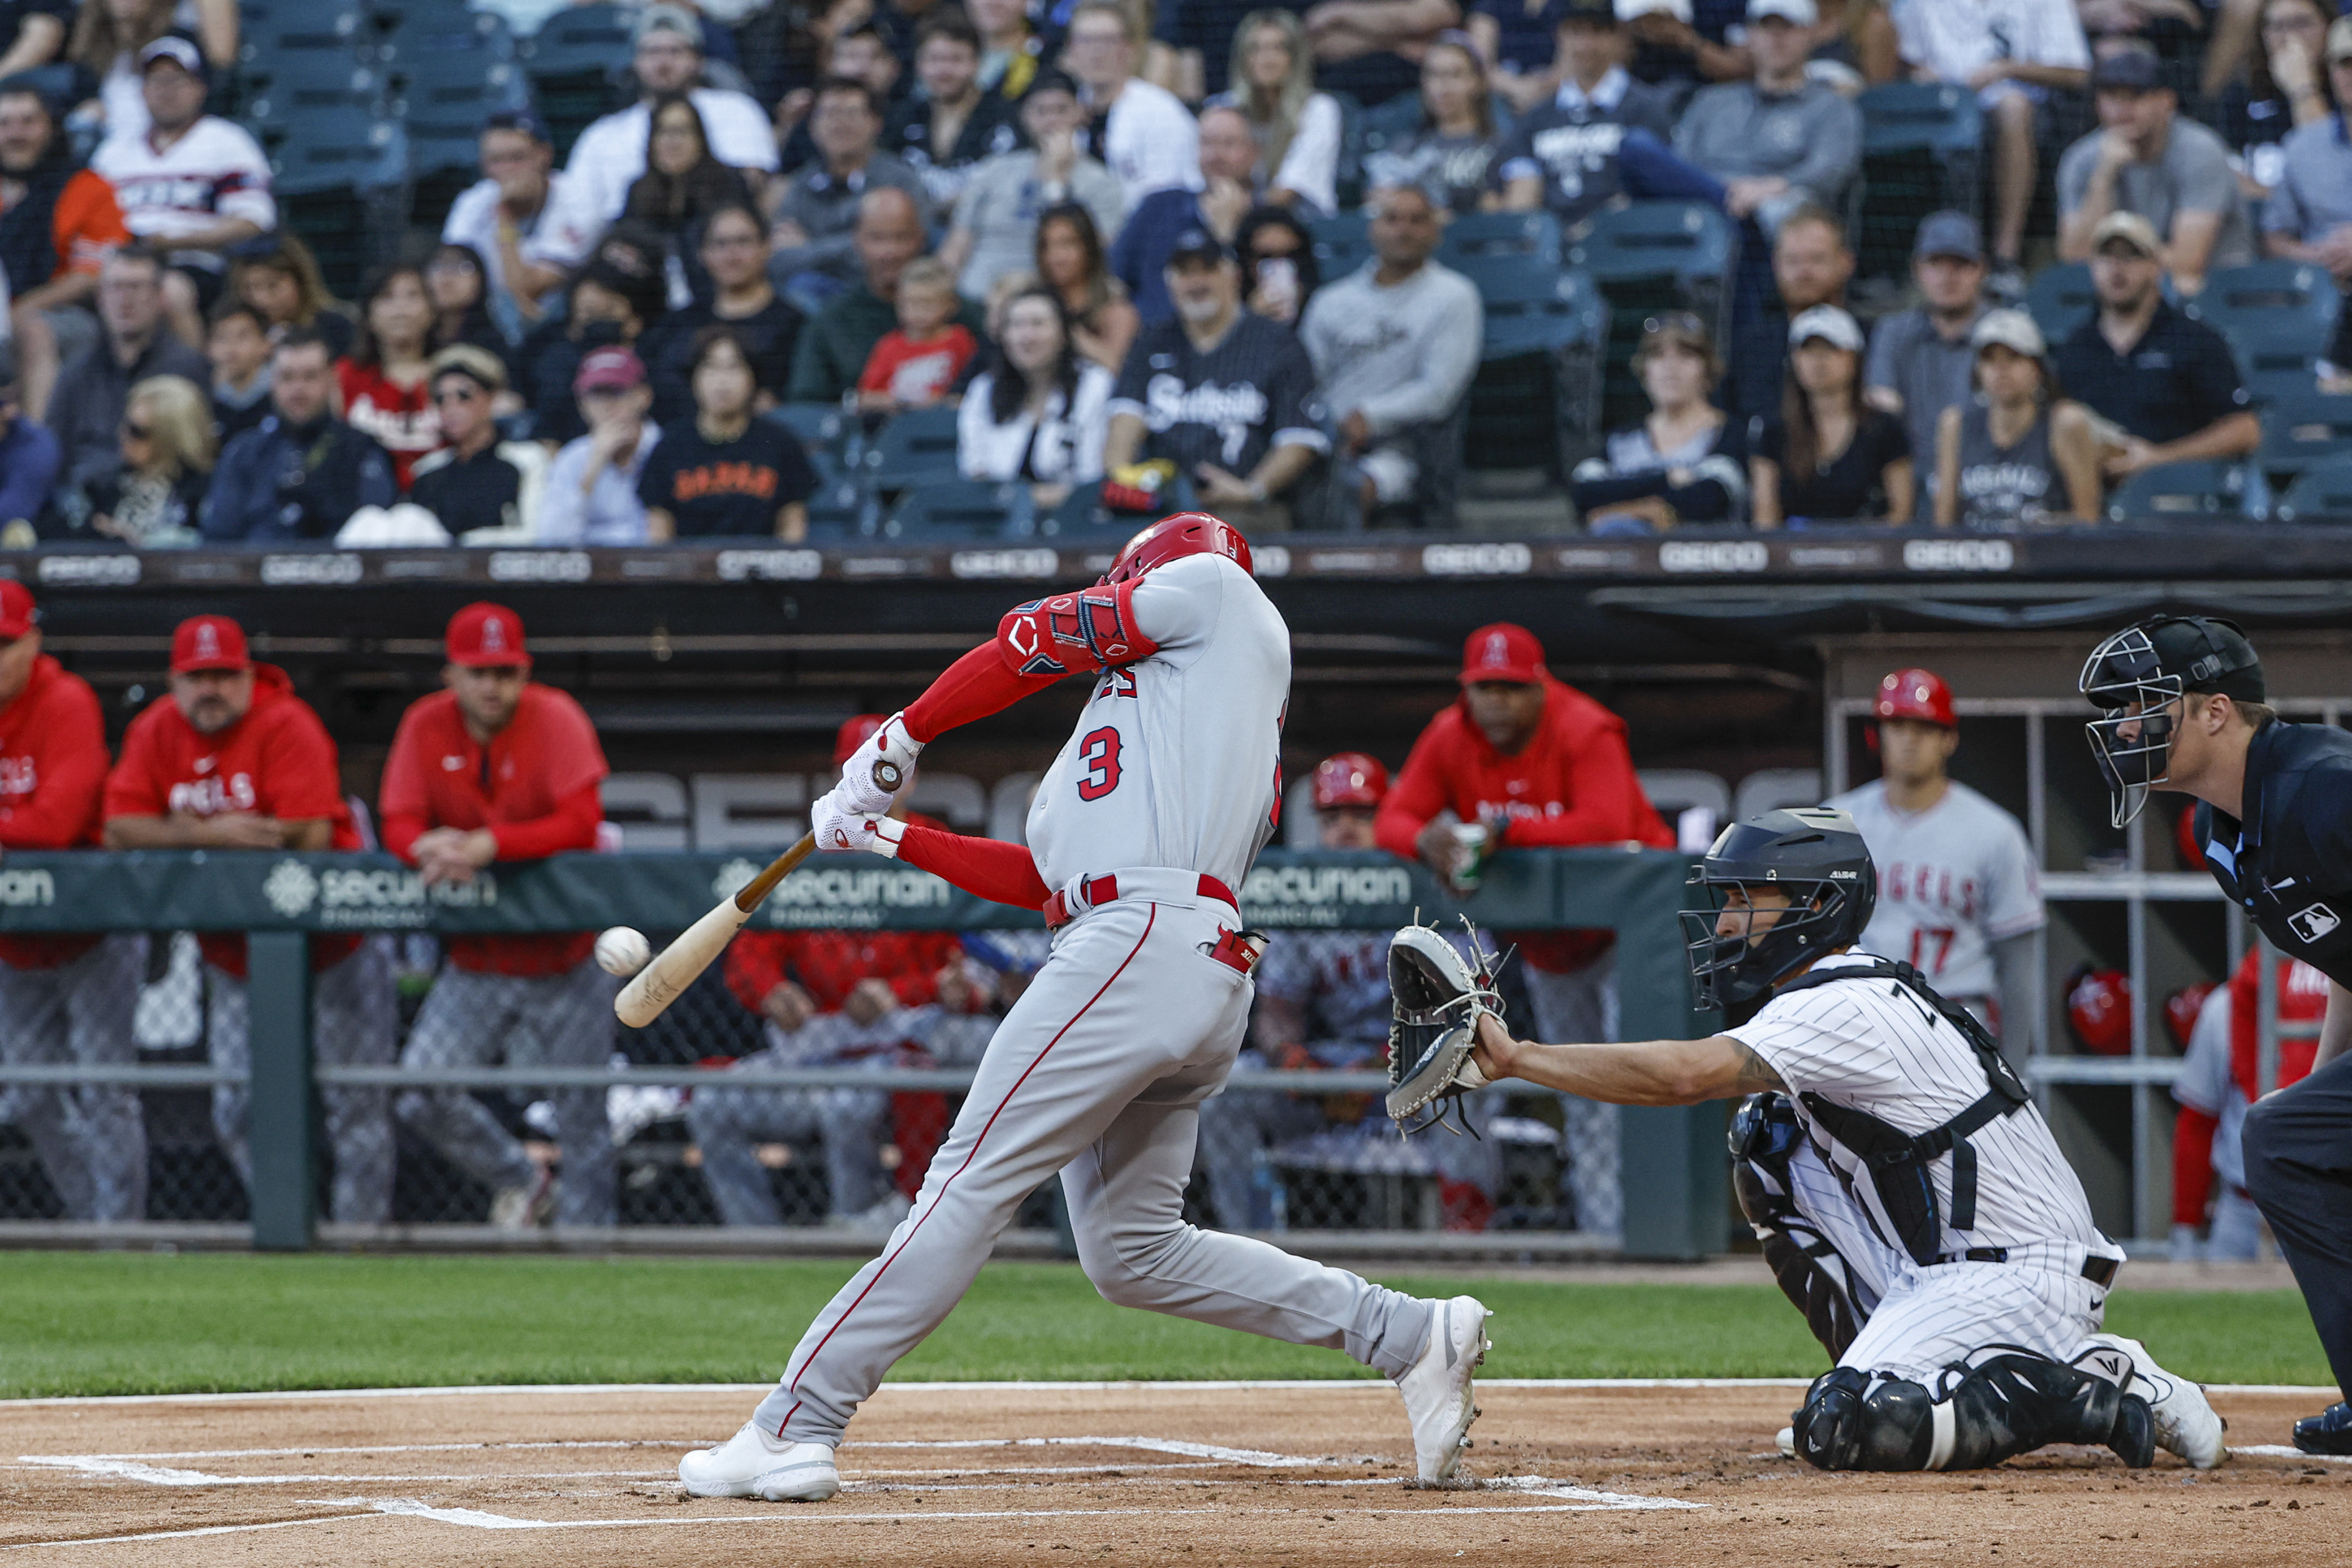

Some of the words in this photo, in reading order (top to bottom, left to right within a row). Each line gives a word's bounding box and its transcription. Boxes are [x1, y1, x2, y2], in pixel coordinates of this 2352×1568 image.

[1228, 546, 1237, 559] 3
[1422, 543, 1531, 574] GEICO
[1659, 541, 1768, 573] GEICO
[1903, 539, 2014, 571] GEICO
[1077, 725, 1124, 803] 3
[1238, 866, 1412, 905] ecurian
[1242, 905, 1341, 927] INANCIAL
[1909, 925, 1955, 977] 17
